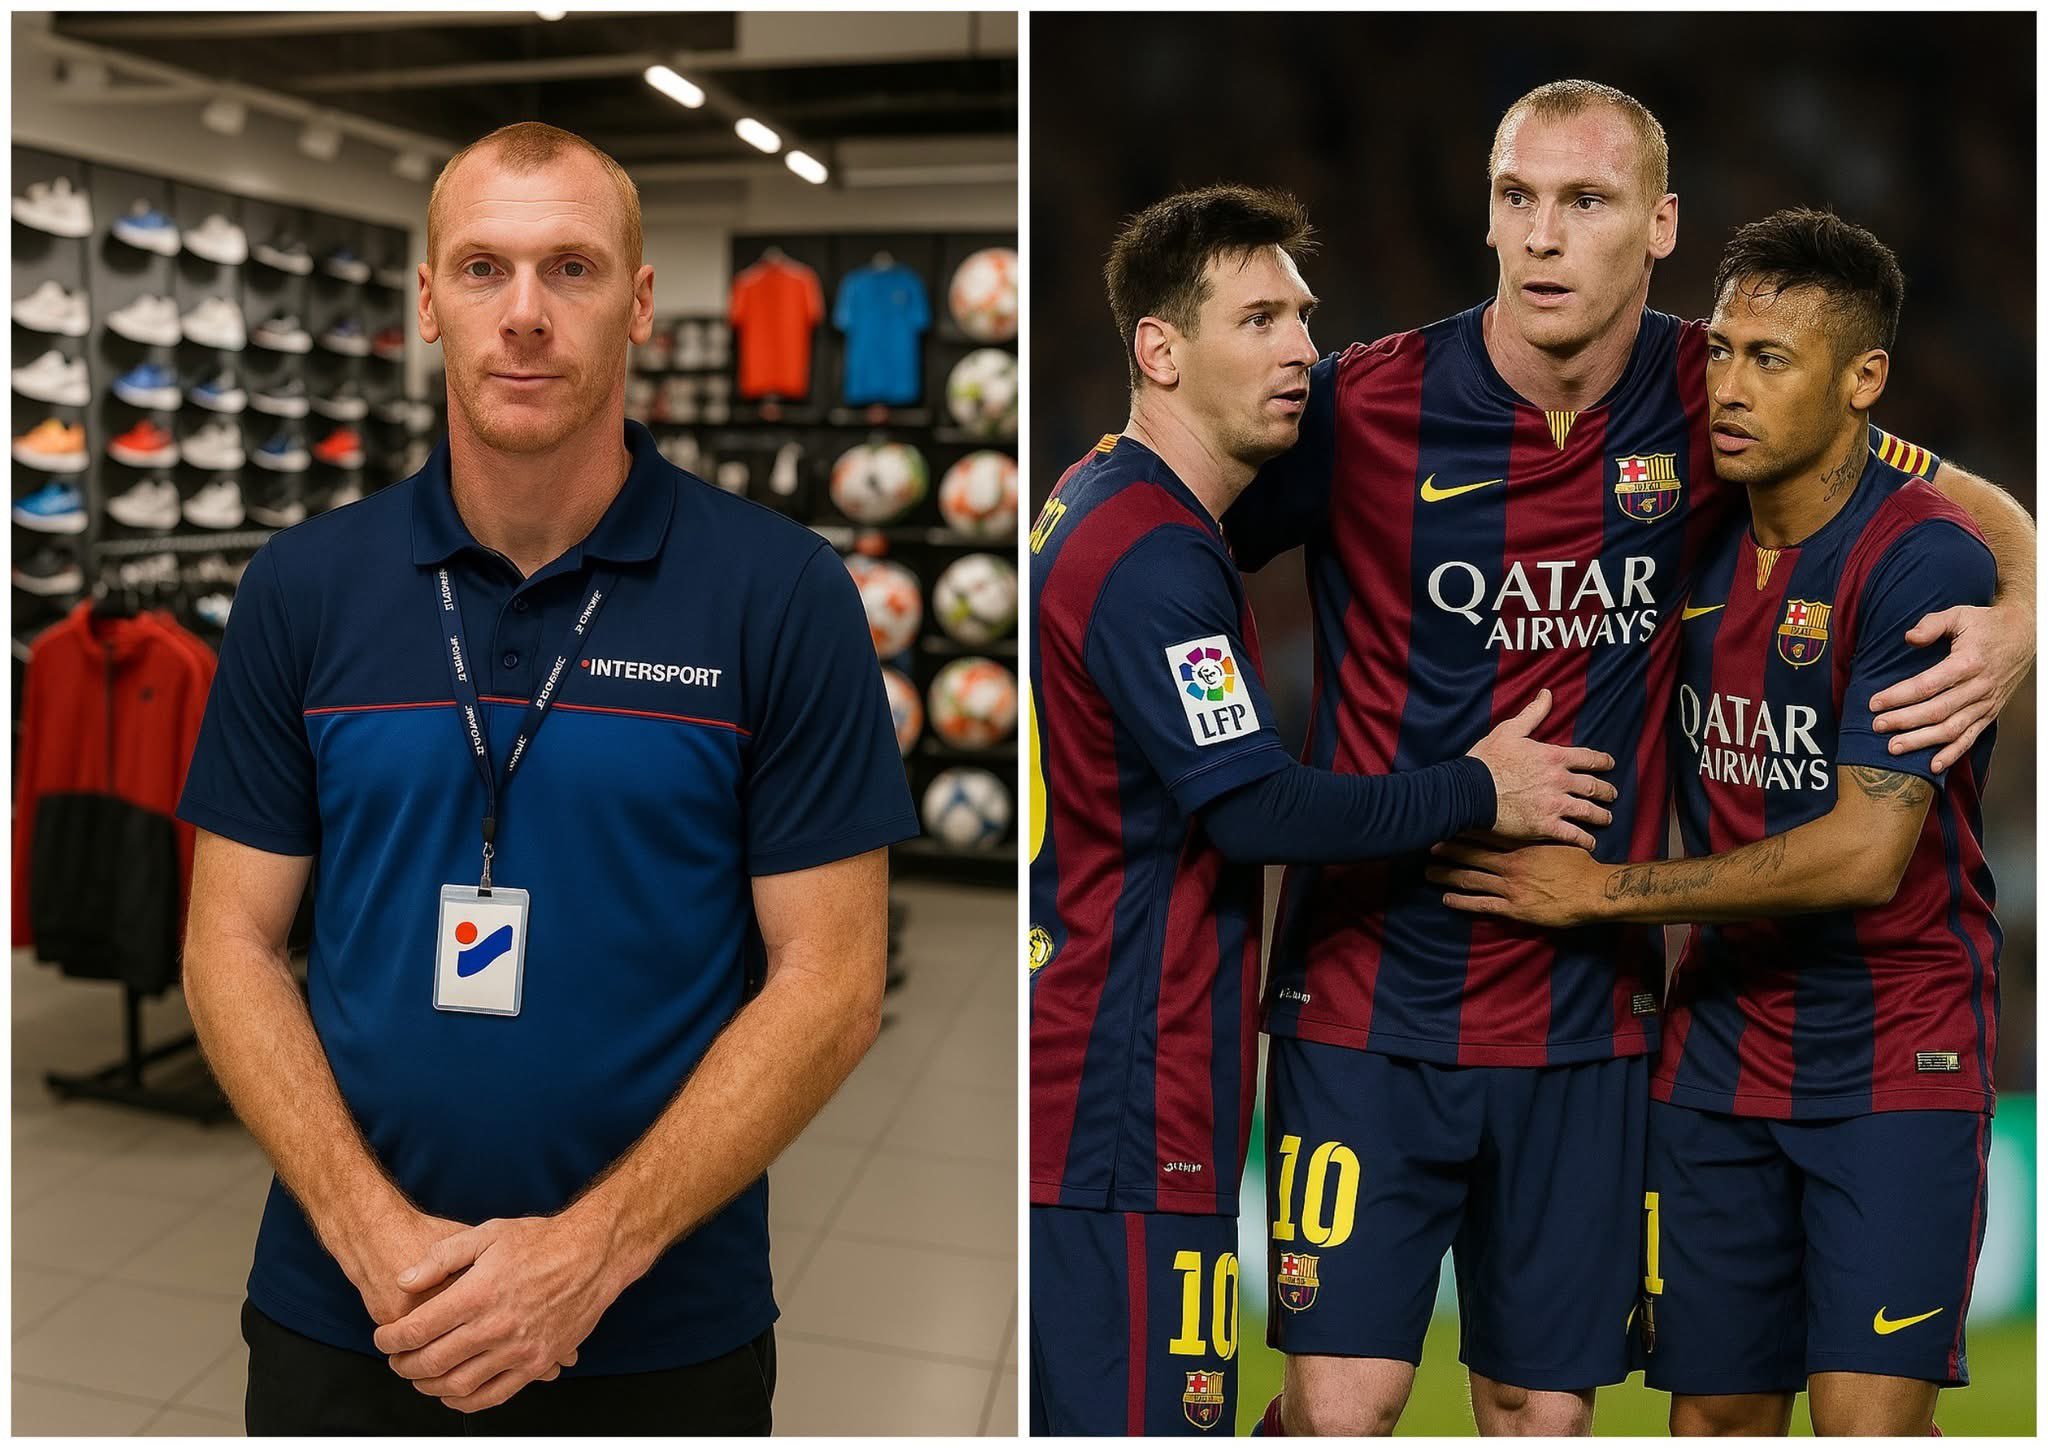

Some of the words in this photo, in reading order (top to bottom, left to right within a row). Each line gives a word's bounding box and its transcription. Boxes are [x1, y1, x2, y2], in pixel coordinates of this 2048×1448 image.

[1428, 556, 1656, 625] QATAR
[1485, 609, 1658, 651] AIRWAYS
[590, 658, 722, 687] INTERSPORT
[1197, 703, 1246, 739] LFP
[1679, 683, 1824, 756] QATAR
[1699, 745, 1830, 791] AIRWAYS
[1272, 1134, 1361, 1248] 10
[1169, 1250, 1239, 1361] 10
